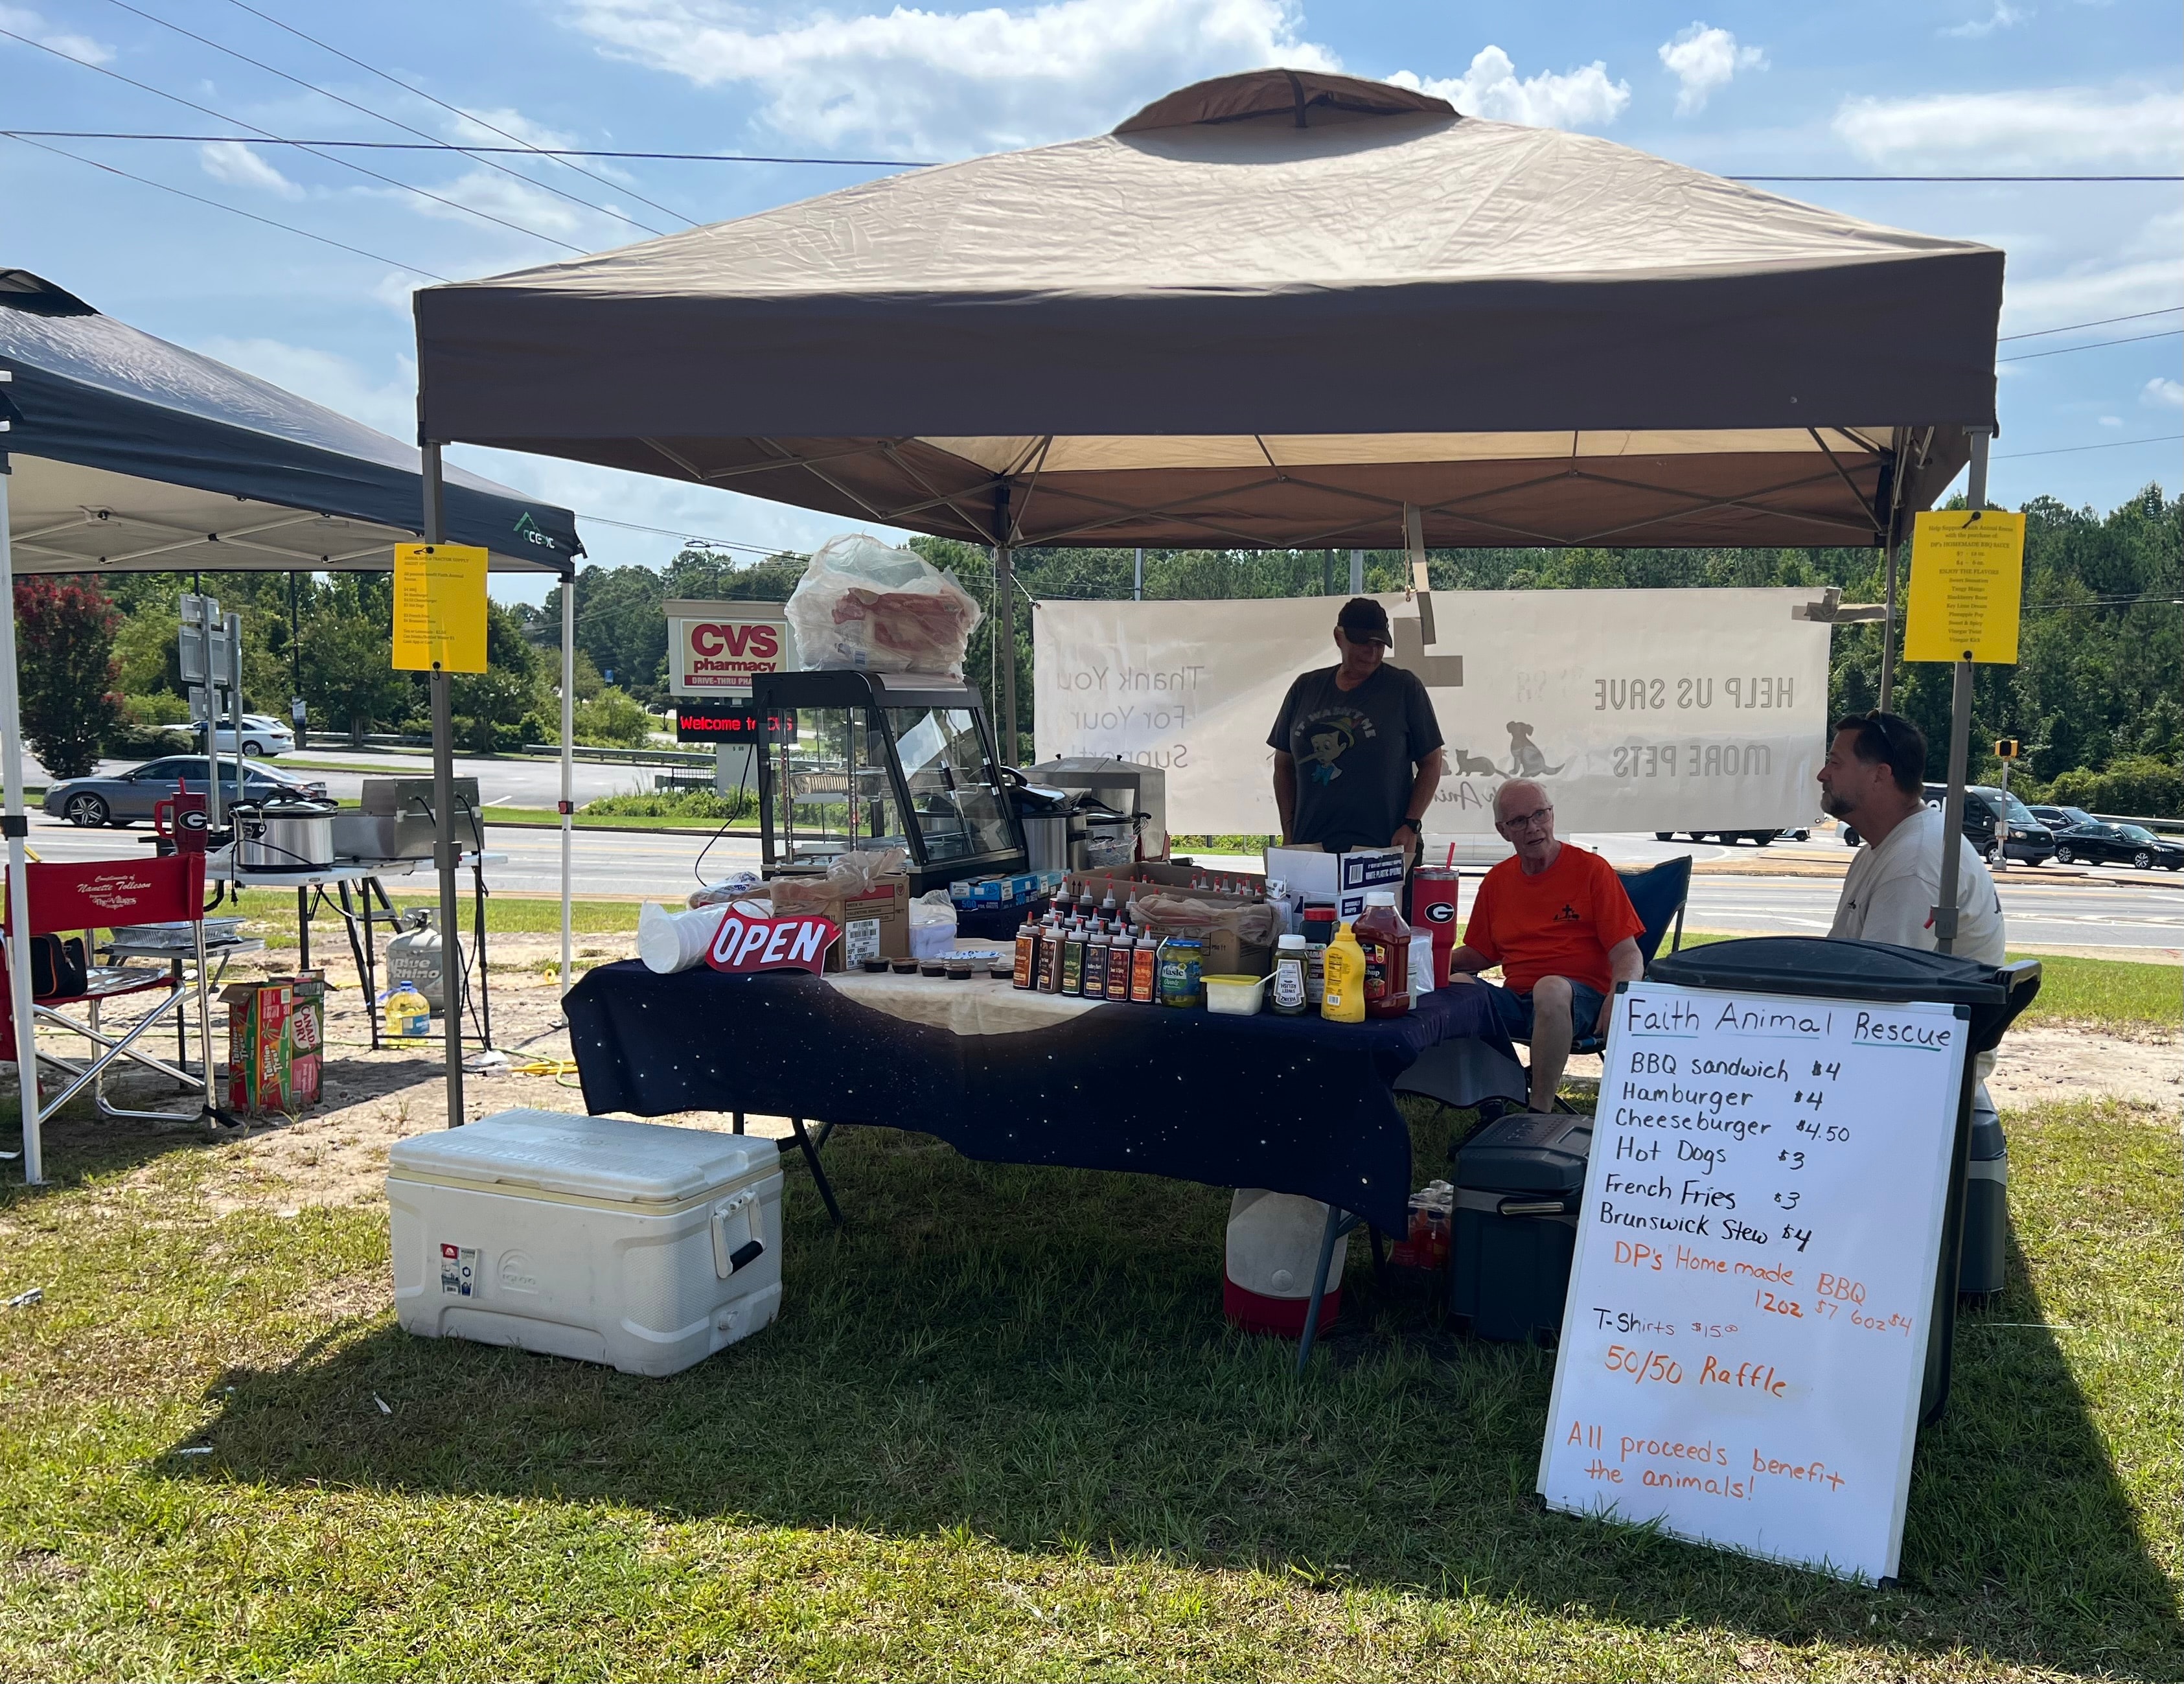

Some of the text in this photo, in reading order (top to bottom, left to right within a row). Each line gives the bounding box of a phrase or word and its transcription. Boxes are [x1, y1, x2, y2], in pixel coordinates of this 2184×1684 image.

[691, 623, 778, 658] CVS
[694, 658, 776, 673] pharmacy
[680, 716, 741, 730] Welcome
[77, 881, 152, 893] Nanette Tolleson
[961, 900, 976, 908] 500
[713, 917, 826, 966] OPEN
[393, 969, 440, 978] Rhino
[395, 958, 430, 968] Blue
[294, 1020, 306, 1041] DRY
[301, 1006, 316, 1049] CANADA
[1627, 998, 1951, 1047] Faith Animal Rescue
[264, 1045, 275, 1080] Tahitian
[271, 1048, 283, 1073] Treat
[1631, 1052, 1841, 1081] BBQ sandwich $4
[1623, 1081, 1823, 1114] Hamburger $4
[1616, 1107, 1850, 1143] Cheeseburger $4.50
[1616, 1136, 1805, 1175] Hot Dogs $3
[1605, 1174, 1800, 1210] French Fries $3
[1600, 1201, 1813, 1252] Brunswick Stew $4
[1615, 1241, 1663, 1271] DP's
[1817, 1273, 1867, 1303] BBQ
[1593, 1308, 1675, 1335] T-Shirts
[1755, 1289, 1913, 1337] 12oz $7 6oz $4
[1605, 1345, 1787, 1398] 50/50 Raffle
[1567, 1421, 1845, 1492] All proceeds benefit
[1584, 1459, 1754, 1501] the animals!
